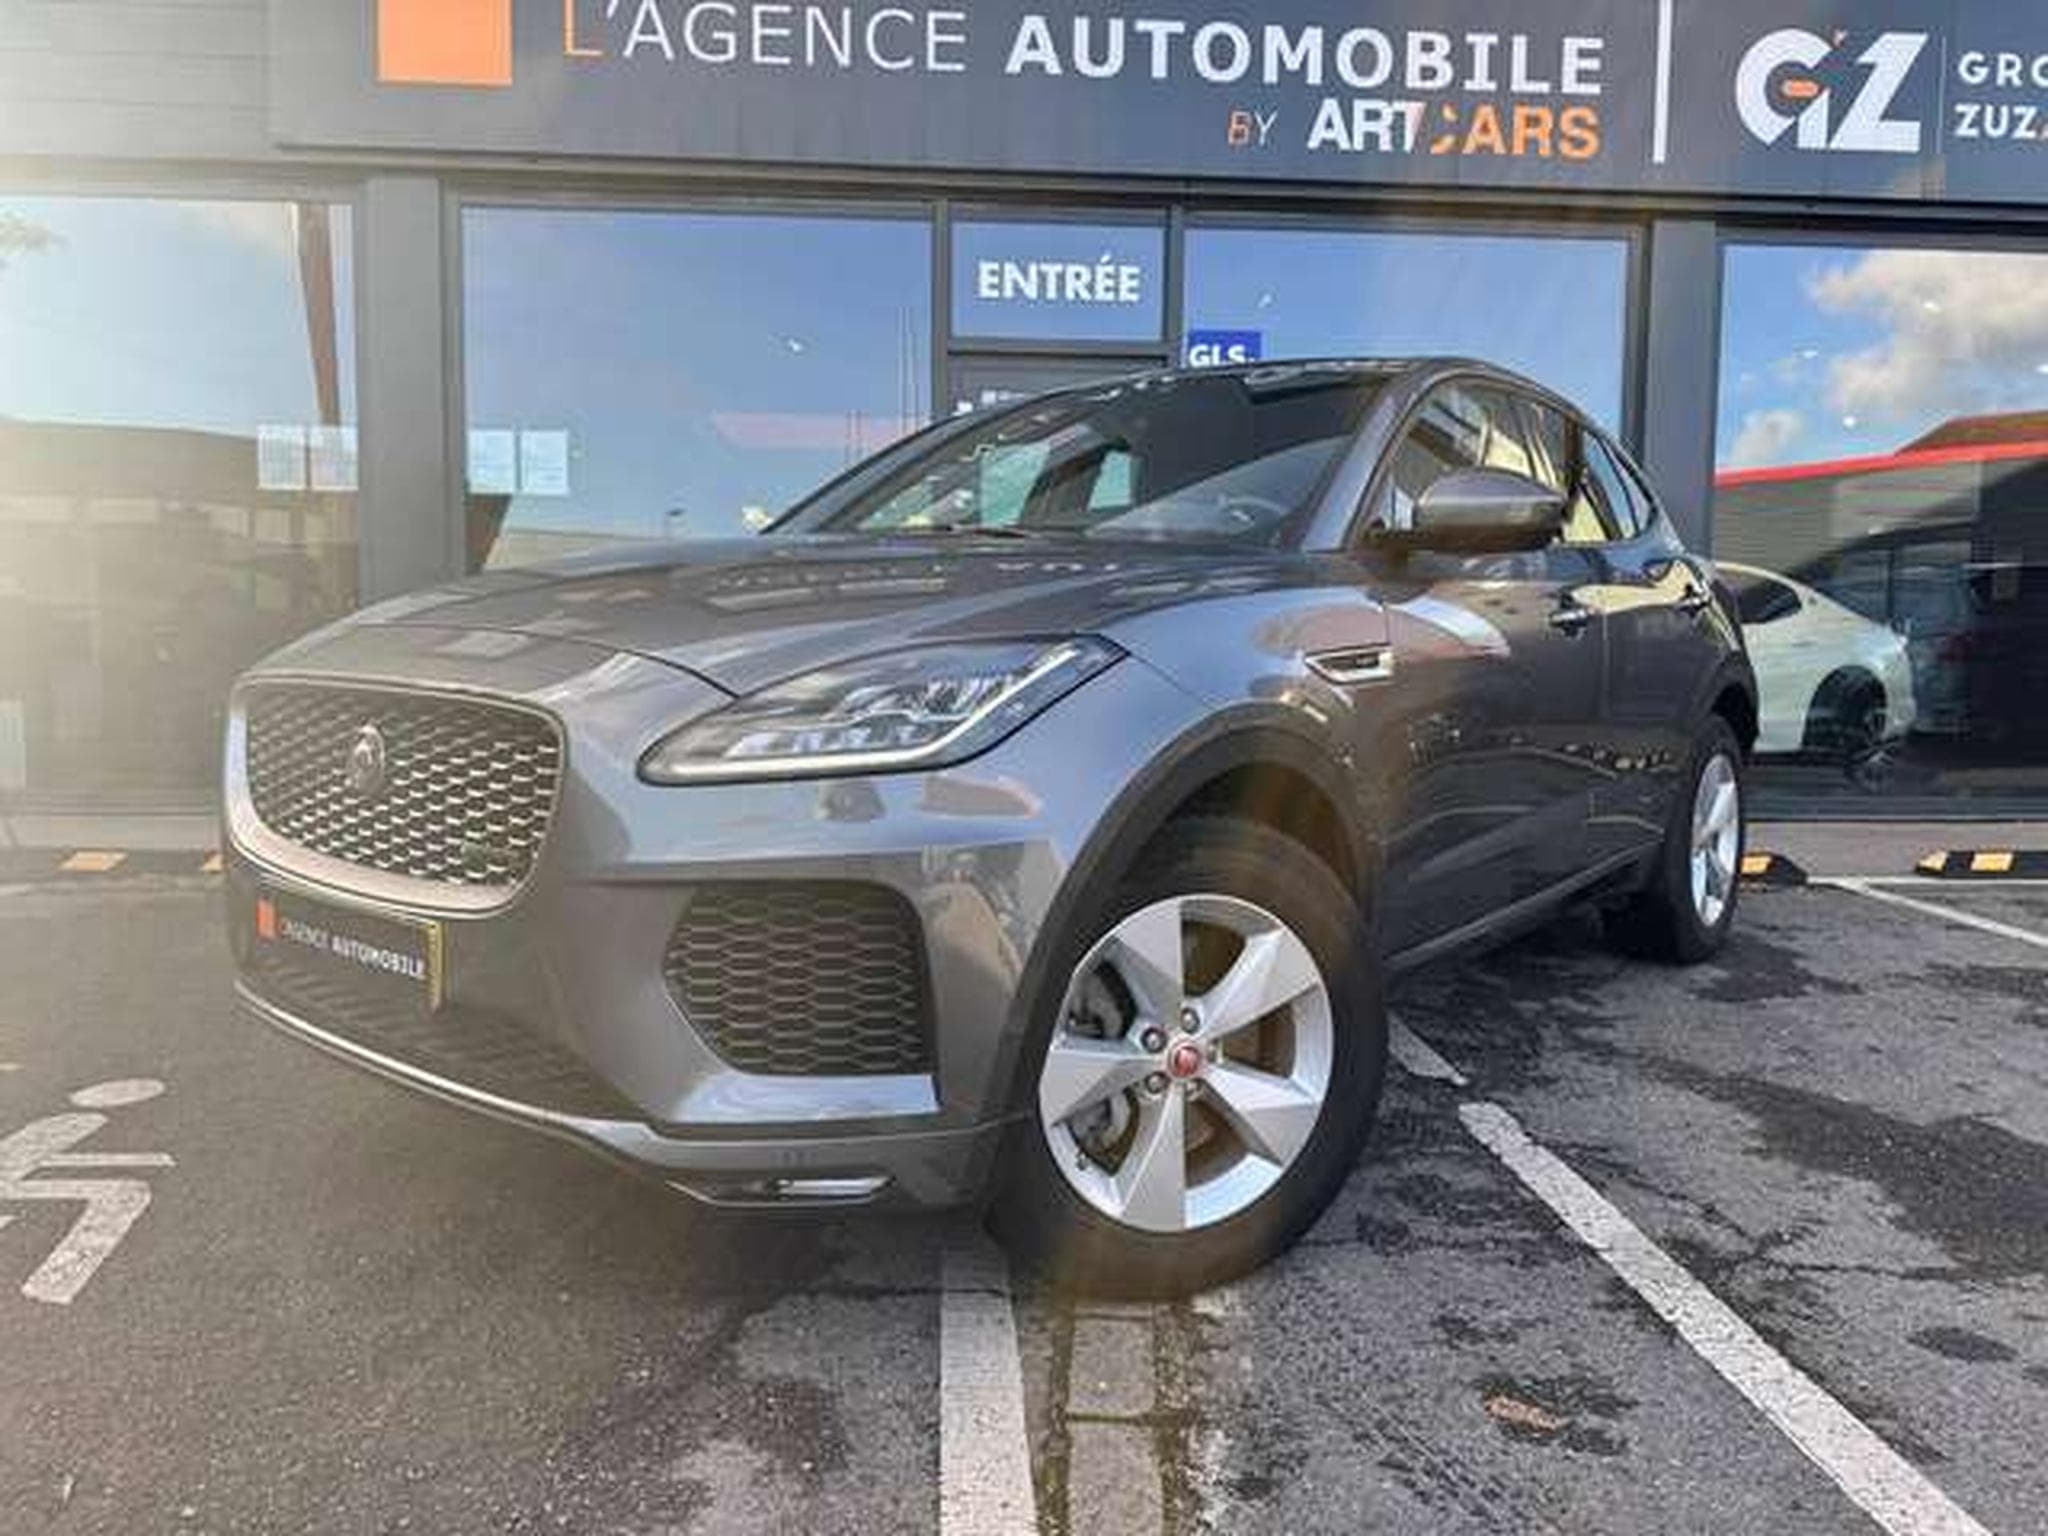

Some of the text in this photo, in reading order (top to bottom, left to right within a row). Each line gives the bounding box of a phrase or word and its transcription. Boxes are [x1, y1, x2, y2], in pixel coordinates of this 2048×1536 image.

[563, 0, 1603, 94] L'AGENCE AUTOMOBILE
[1227, 110, 1277, 146] BY
[1954, 103, 2048, 138] ZUZ
[978, 254, 1140, 302] ENTRÉE
